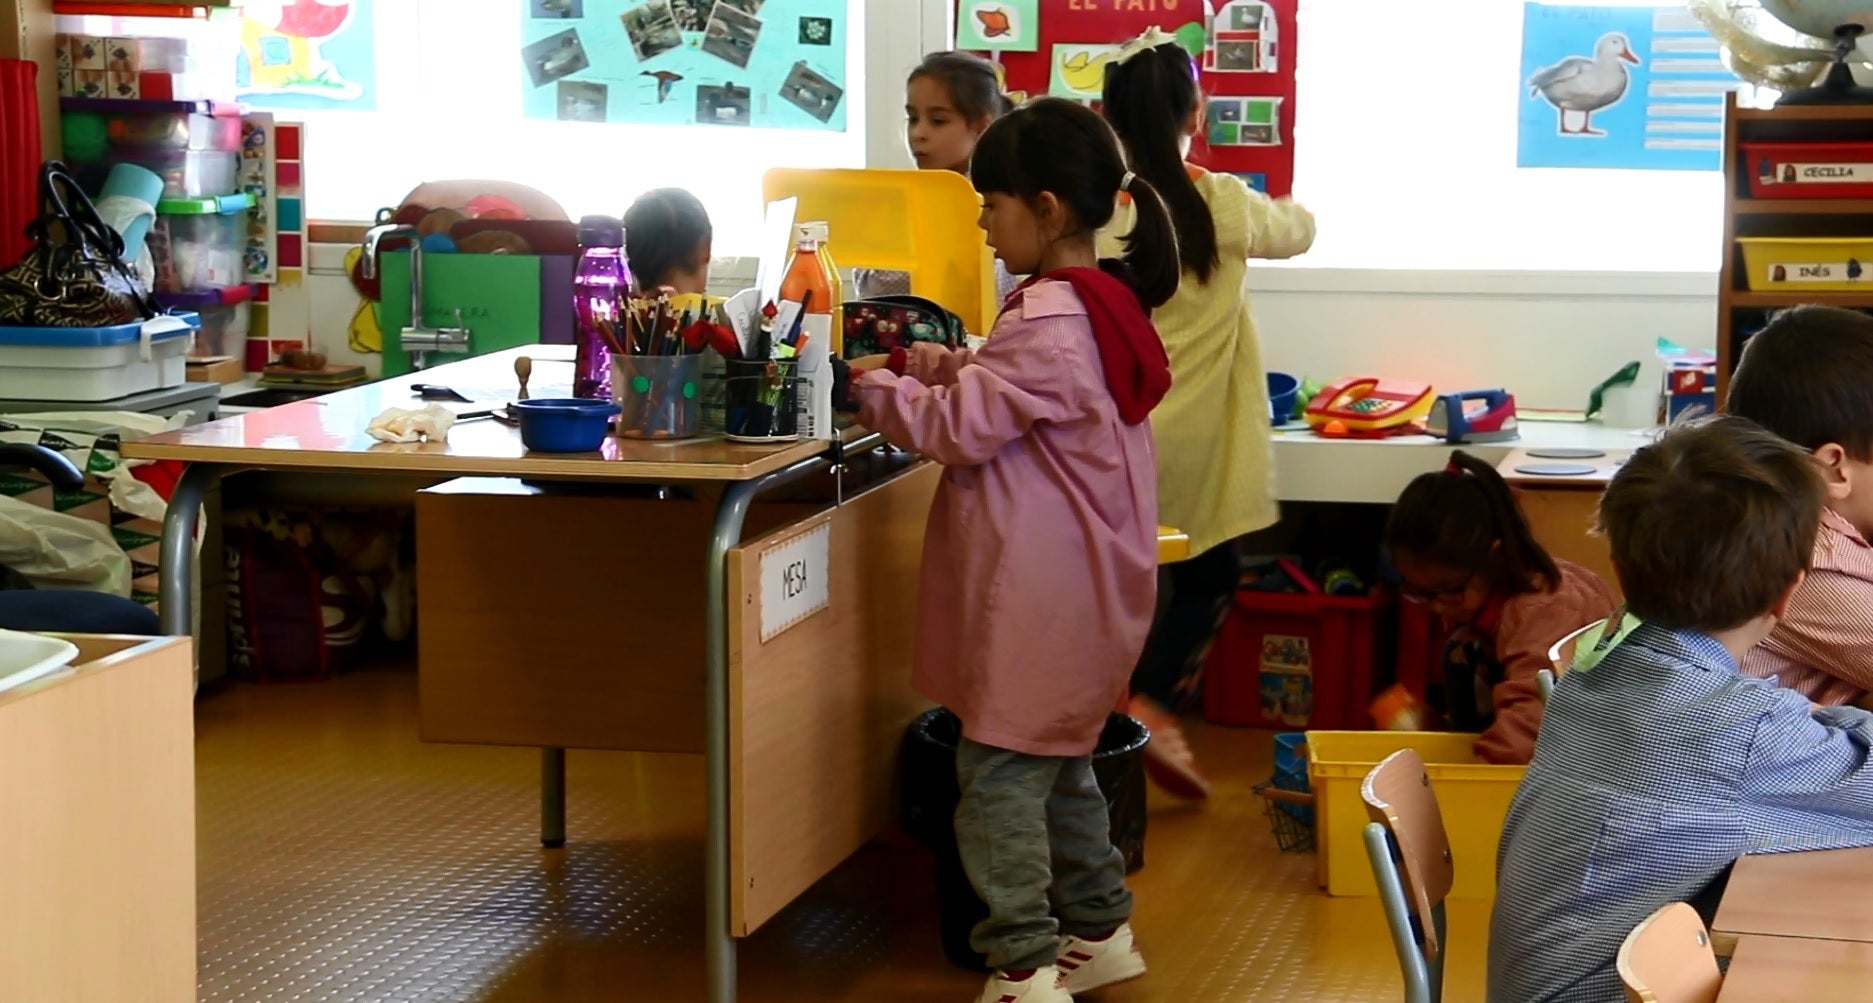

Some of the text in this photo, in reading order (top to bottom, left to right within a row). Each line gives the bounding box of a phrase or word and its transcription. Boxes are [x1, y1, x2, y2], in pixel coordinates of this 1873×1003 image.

[1803, 166, 1854, 178] CECILIA
[1799, 263, 1830, 278] INÉS
[782, 559, 807, 601] MESA
